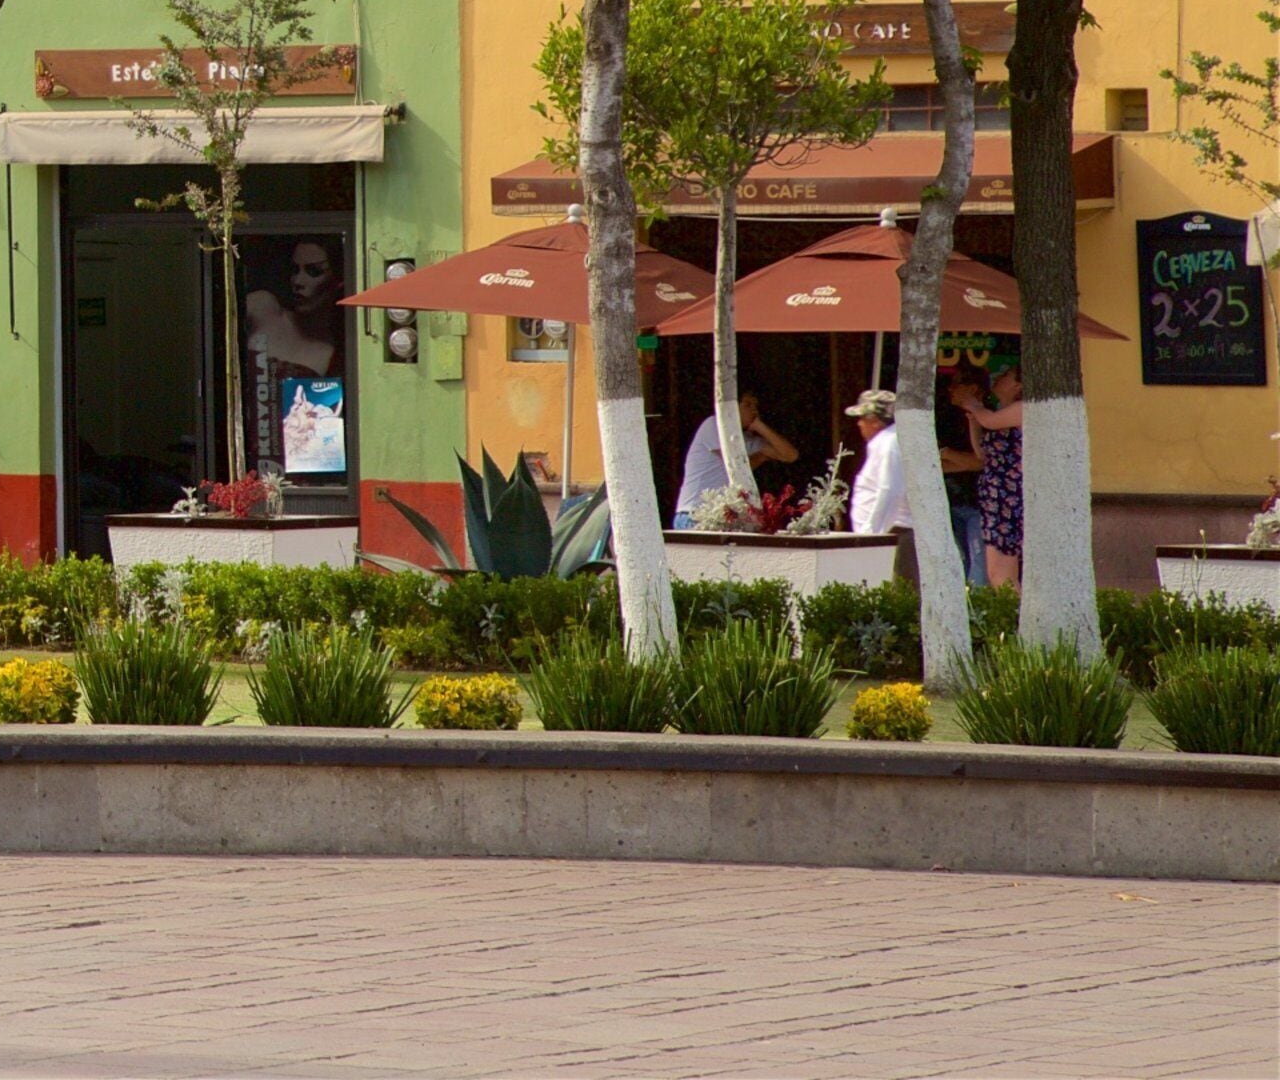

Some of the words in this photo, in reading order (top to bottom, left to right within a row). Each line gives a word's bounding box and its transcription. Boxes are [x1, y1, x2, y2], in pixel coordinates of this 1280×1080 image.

[506, 188, 537, 200] Corona
[766, 180, 817, 199] CAFÉ
[1153, 249, 1236, 291] CERVEZA
[479, 272, 535, 289] Corona
[786, 292, 841, 307] Corona
